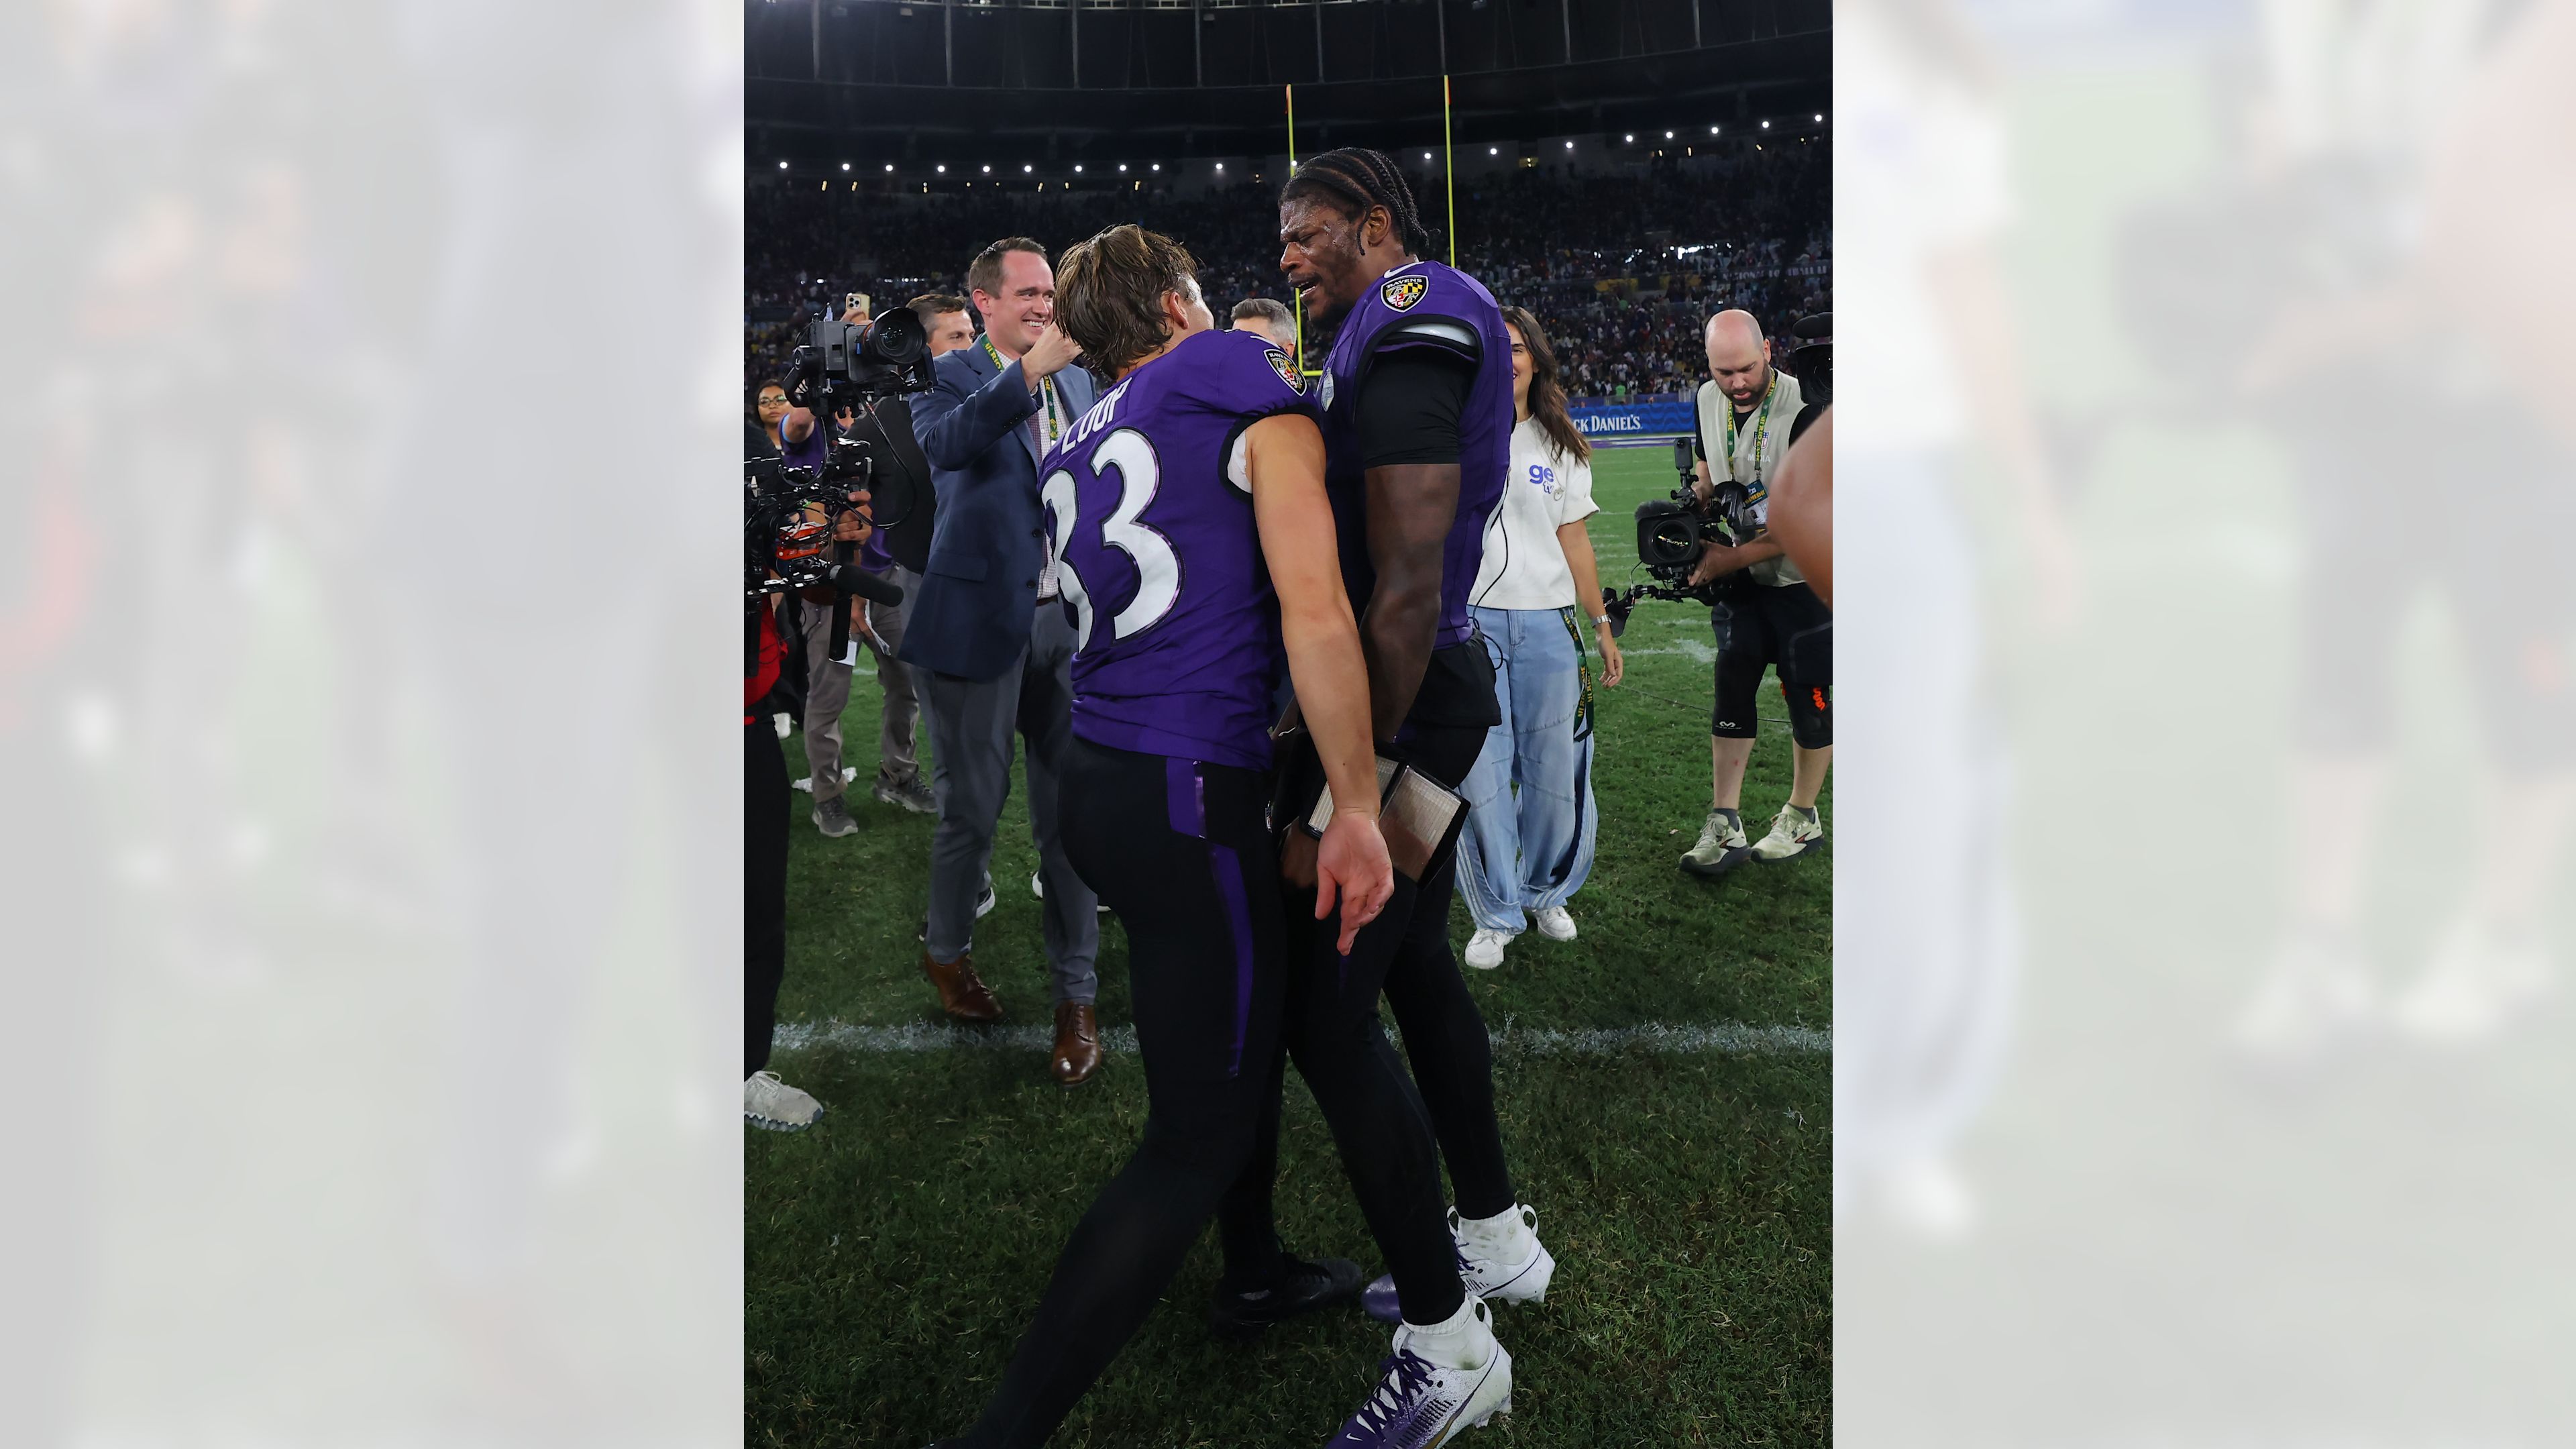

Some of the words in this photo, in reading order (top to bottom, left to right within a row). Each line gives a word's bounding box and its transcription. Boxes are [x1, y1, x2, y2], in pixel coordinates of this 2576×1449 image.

[1385, 278, 1423, 289] RAVENS
[1061, 376, 1132, 455] LOOP
[1573, 419, 1589, 433] CK
[1748, 453, 1771, 462] MDIA
[1529, 464, 1554, 484] ge
[1542, 480, 1554, 494] tv
[1040, 427, 1185, 655] 33
